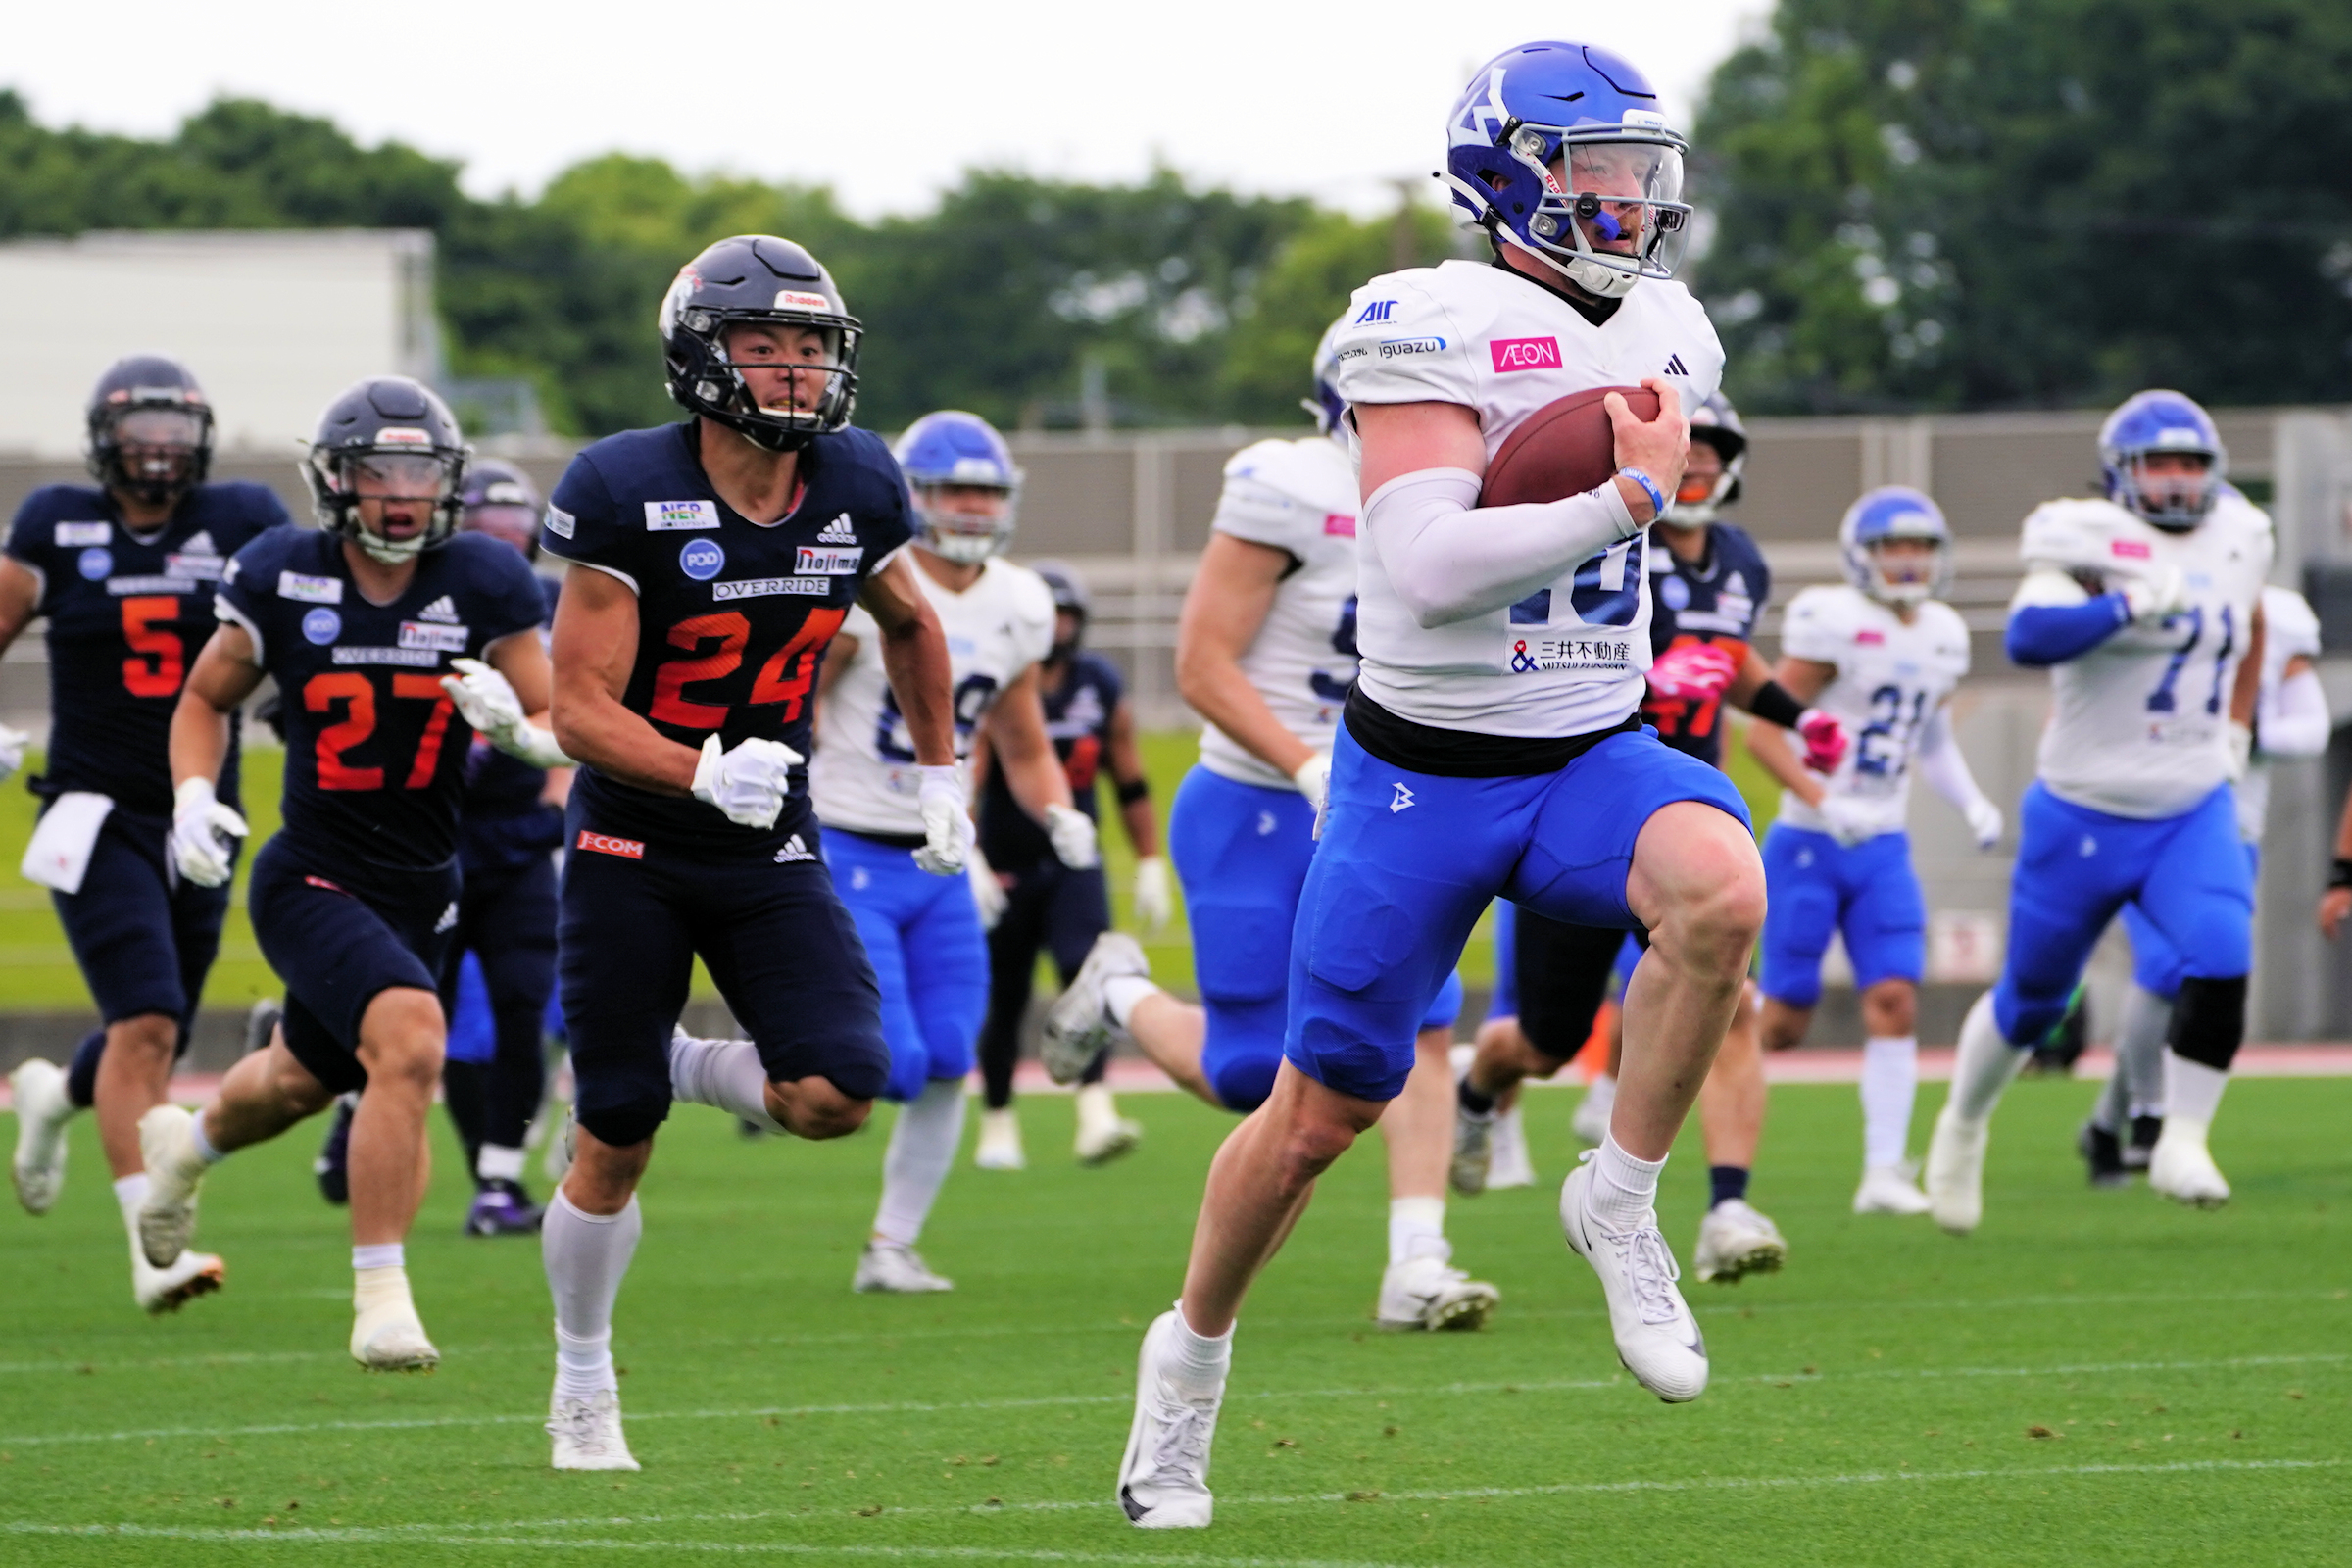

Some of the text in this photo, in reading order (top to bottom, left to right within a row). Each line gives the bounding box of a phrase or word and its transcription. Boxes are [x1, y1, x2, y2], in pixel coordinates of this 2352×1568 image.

[1379, 338, 1441, 359] iguazu
[716, 579, 827, 597] OVERRIDE
[122, 596, 183, 697] 5
[649, 608, 845, 728] 24
[1540, 640, 1630, 661] 三井不動産
[2147, 605, 2232, 714] 71
[303, 671, 461, 790] 27
[1856, 685, 1926, 776] 21
